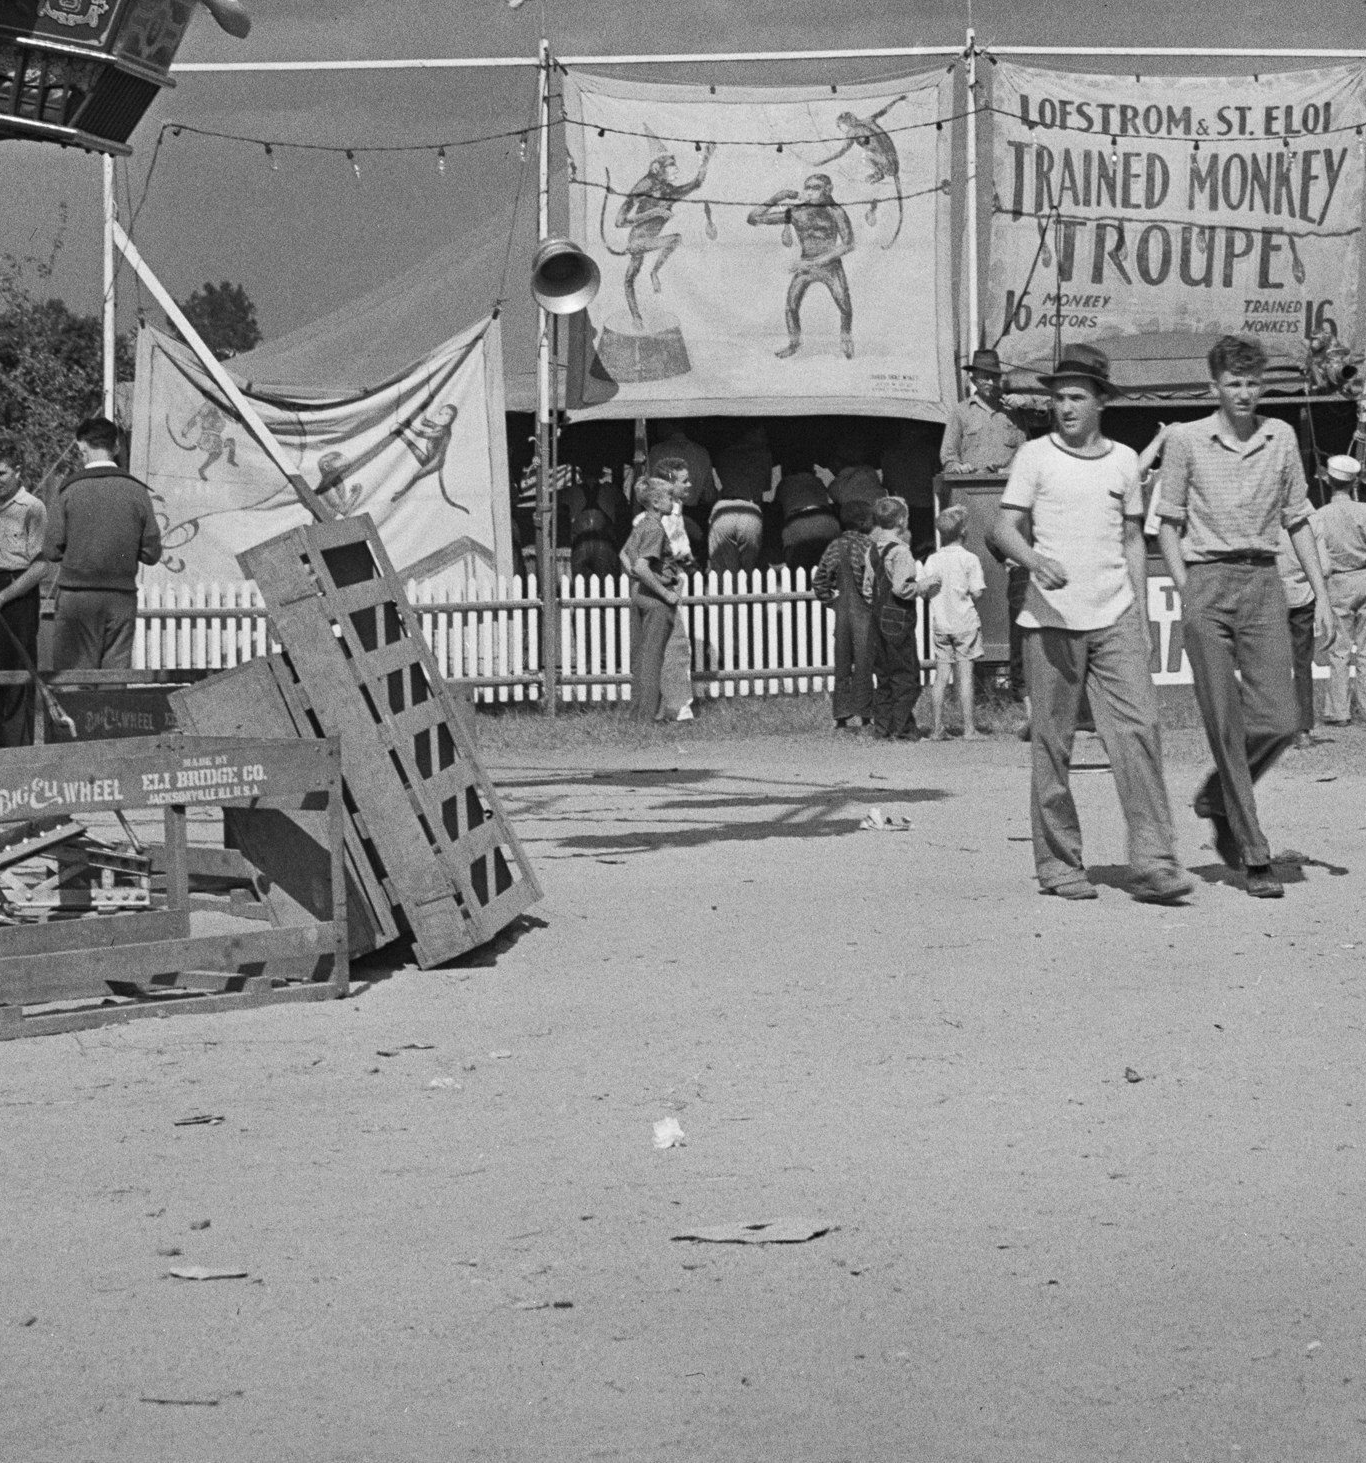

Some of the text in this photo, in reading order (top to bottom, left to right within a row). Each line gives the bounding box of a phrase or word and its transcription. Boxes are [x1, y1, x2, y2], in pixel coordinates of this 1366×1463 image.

[1019, 93, 1331, 137] LOFSTROM & ST. ELOI
[1007, 140, 1348, 226] TRAINED MONKEY
[1053, 220, 1285, 289] TROUPE
[1001, 290, 1032, 336] 16
[1042, 293, 1112, 309] MONKEY
[1244, 299, 1302, 314] TRAINED
[1035, 313, 1098, 329] ACTORS
[1240, 319, 1302, 334] MONKEYS
[1304, 299, 1338, 340] 16
[63, 778, 124, 804] WHEEL
[141, 764, 268, 791] ELI BRIDGE CO.
